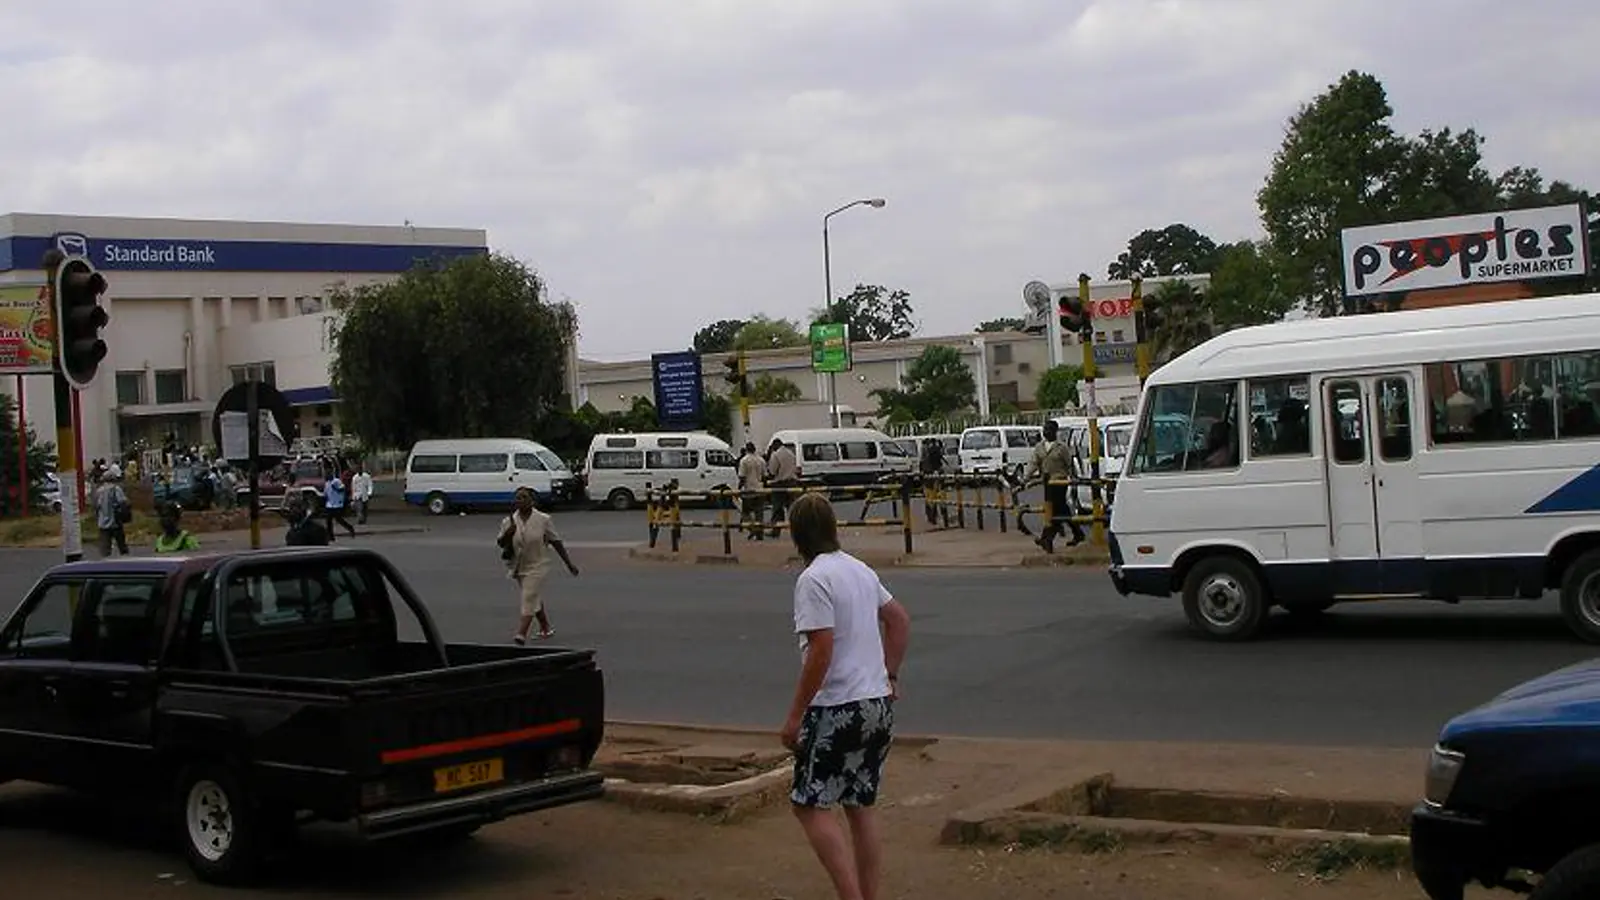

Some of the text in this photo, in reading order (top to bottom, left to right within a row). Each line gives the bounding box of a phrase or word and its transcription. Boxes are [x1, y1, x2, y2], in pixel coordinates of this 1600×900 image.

[104, 244, 215, 263] Standard Bank
[1353, 216, 1574, 290] peoples
[1477, 257, 1575, 278] SUPERMARKET
